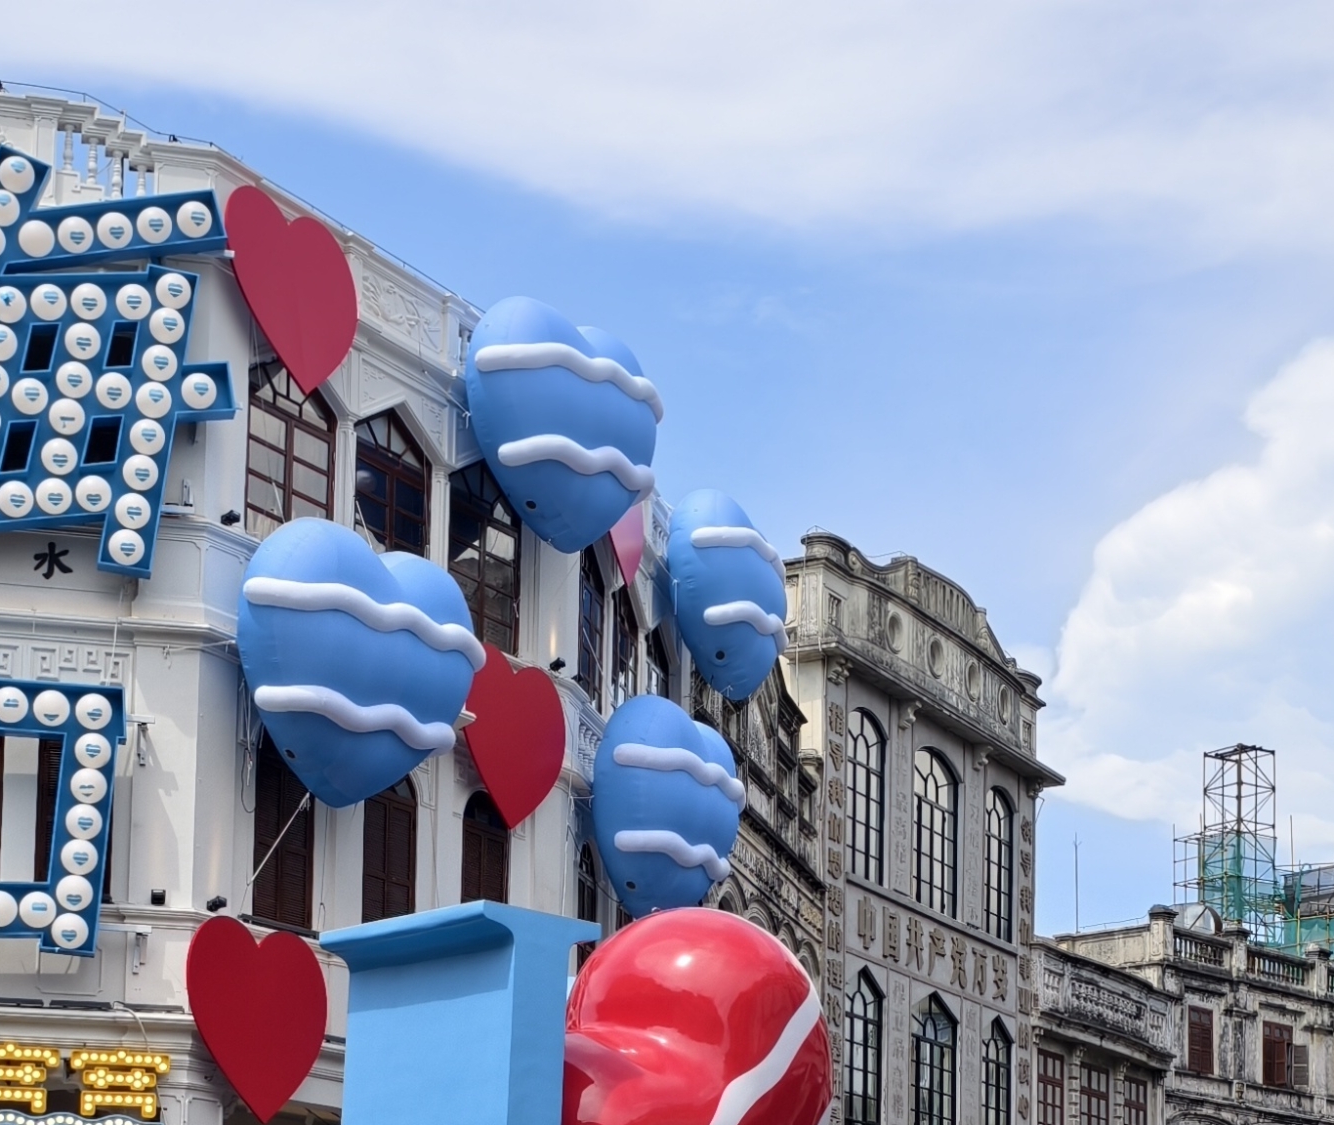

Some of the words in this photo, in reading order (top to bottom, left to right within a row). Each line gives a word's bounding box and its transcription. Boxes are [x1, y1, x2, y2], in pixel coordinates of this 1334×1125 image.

[858, 895, 1008, 1002] 中国共产党万岁
